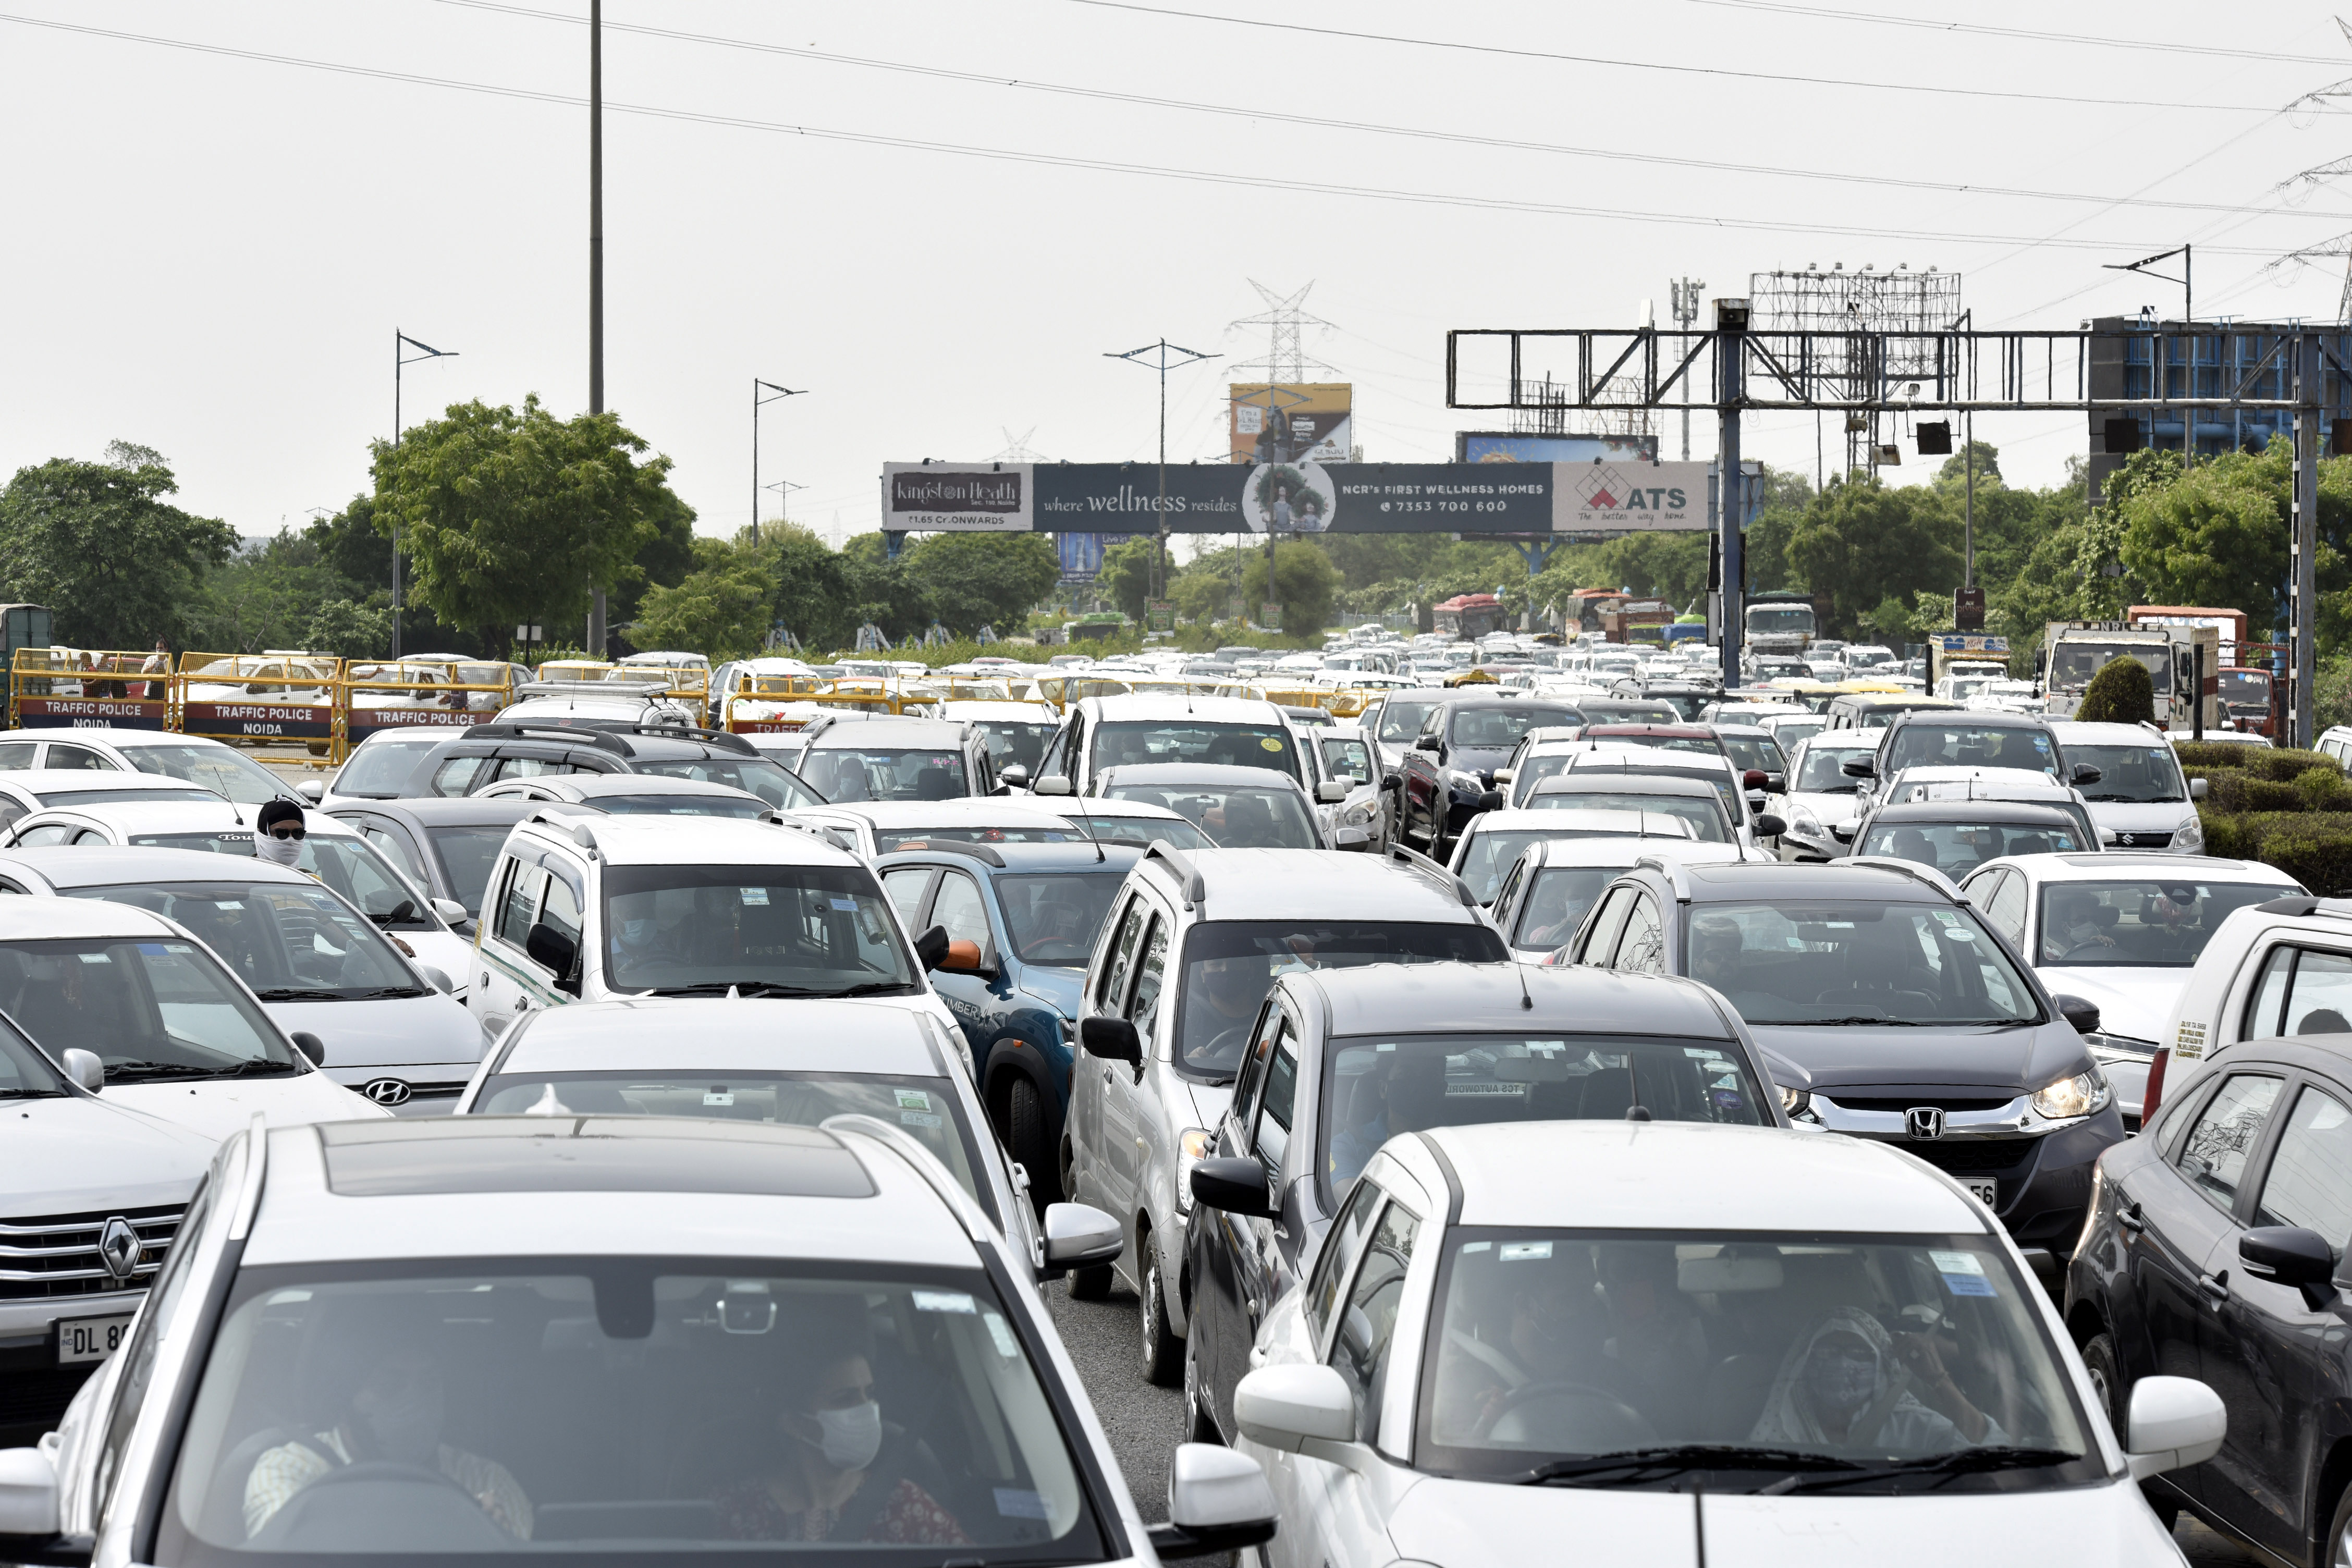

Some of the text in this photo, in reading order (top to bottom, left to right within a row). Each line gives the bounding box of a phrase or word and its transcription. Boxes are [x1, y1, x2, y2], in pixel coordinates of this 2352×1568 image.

[970, 482, 1015, 499] Heath
[1385, 485, 1421, 494] FIRST
[1426, 485, 1494, 494] WELLNESS
[1498, 484, 1544, 495] HOMES
[1044, 484, 1237, 512] where wellness resides
[1625, 488, 1686, 510] ATS
[1396, 500, 1506, 512] 7353 700 600
[1578, 512, 1592, 520] The
[1601, 511, 1628, 520] better
[1637, 513, 1654, 526] way
[46, 701, 141, 716] TRAFFIC POLICE
[215, 705, 312, 720] TRAFFIC POLICE
[74, 718, 111, 729] NOIDA
[375, 711, 475, 725] TRAFFIC POLICE
[243, 723, 282, 735] NOIDA
[61, 1338, 74, 1346] IND
[74, 1327, 100, 1354] DL
